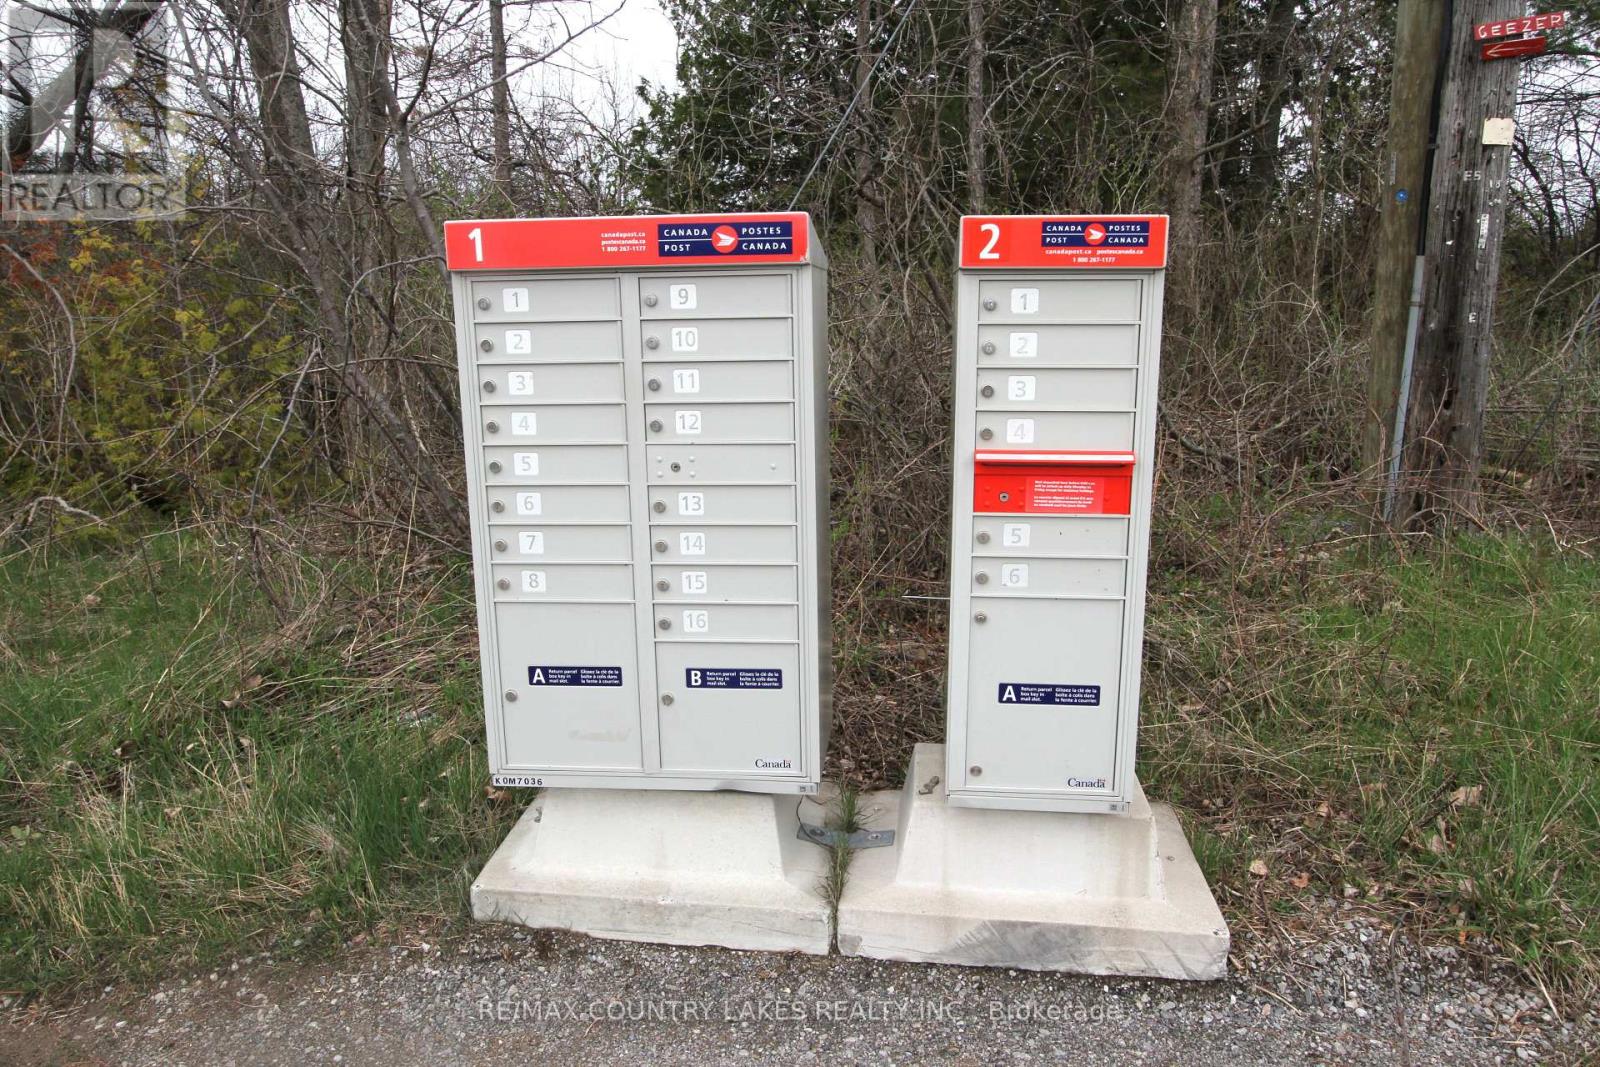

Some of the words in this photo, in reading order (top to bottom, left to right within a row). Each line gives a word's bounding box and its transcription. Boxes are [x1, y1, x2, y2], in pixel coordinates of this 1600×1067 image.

[1478, 15, 1561, 38] GEEZER
[664, 229, 708, 237] CANADA
[742, 227, 781, 235] POSTES
[468, 228, 483, 262] 1
[664, 244, 691, 252] POST
[742, 242, 787, 250] CANADA
[980, 224, 1000, 259] 2
[678, 288, 689, 305] 9
[513, 334, 524, 350] 2
[676, 331, 696, 347] 10
[1016, 337, 1028, 354] 2
[516, 375, 526, 391] 3
[678, 373, 694, 389] 11
[1016, 380, 1026, 398] 3
[518, 416, 529, 431] 4
[680, 414, 698, 430] 12
[1014, 424, 1026, 440] 4
[521, 456, 531, 471] 5
[524, 496, 534, 511] 6
[682, 496, 702, 511] 13
[526, 535, 536, 550] 7
[684, 536, 703, 551] 14
[1011, 528, 1021, 544] 5
[529, 573, 539, 588] 8
[685, 575, 705, 590] 15
[1010, 568, 1020, 584] 6
[687, 614, 706, 629] 16
[532, 668, 545, 684] A
[691, 670, 702, 686] B
[1002, 686, 1017, 702] A
[755, 759, 791, 768] Canada
[1067, 778, 1105, 788] Canada
